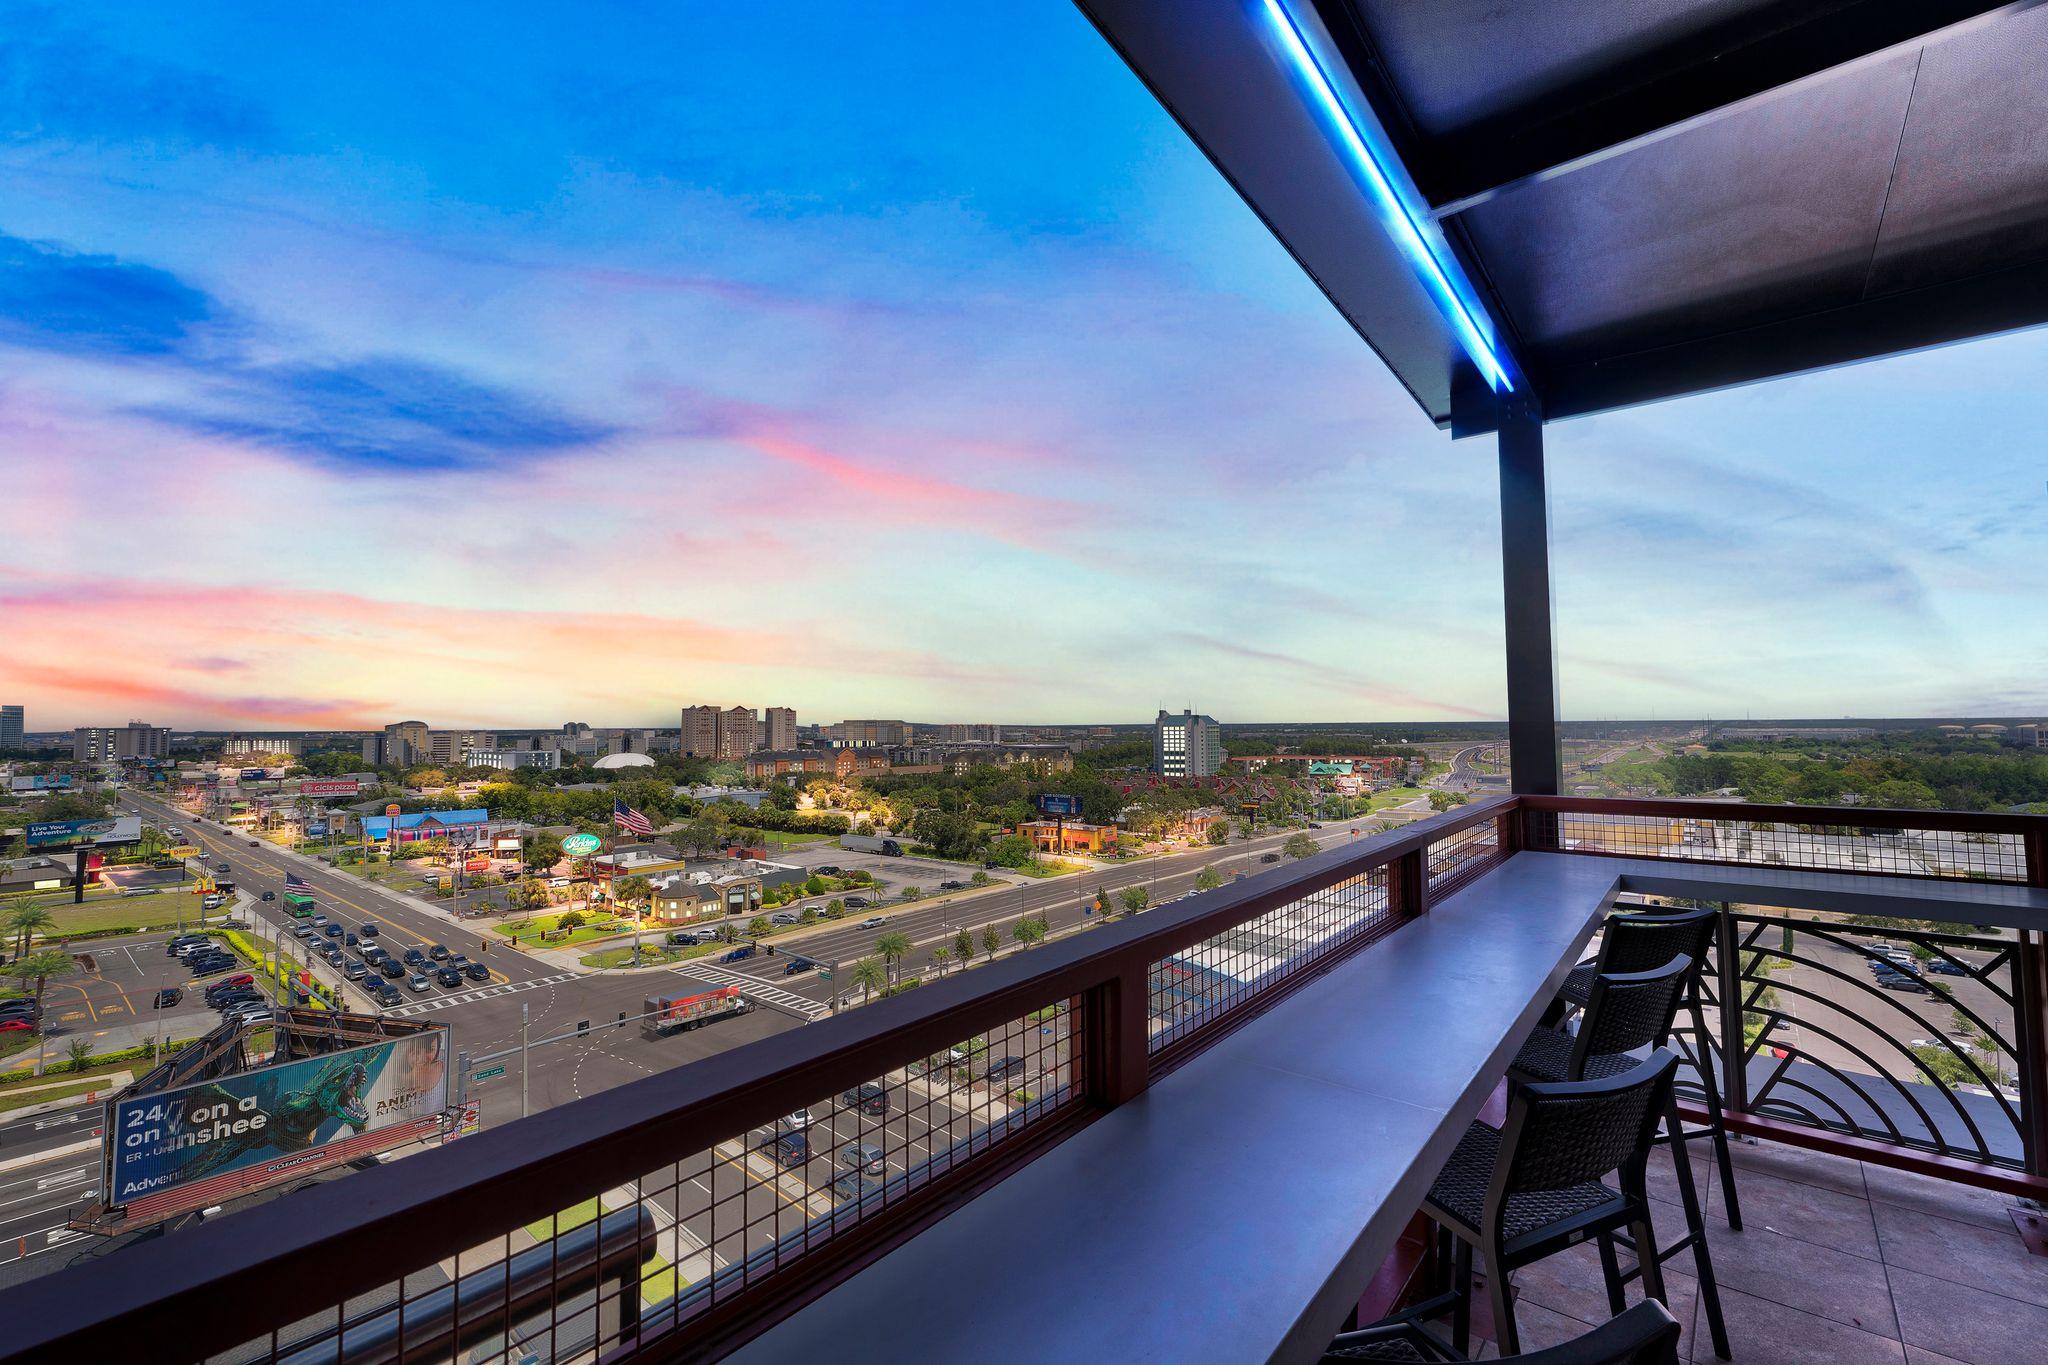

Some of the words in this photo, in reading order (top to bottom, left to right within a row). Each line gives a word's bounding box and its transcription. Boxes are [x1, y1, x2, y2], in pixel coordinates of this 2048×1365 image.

[334, 783, 356, 791] pizza
[49, 823, 67, 831] Your
[31, 828, 72, 837] Adventure
[566, 836, 597, 849] Perkins
[173, 847, 198, 855] Denny's
[190, 1102, 229, 1124] on
[238, 1095, 257, 1112] a
[125, 1127, 160, 1148] on
[126, 1151, 142, 1163] ER
